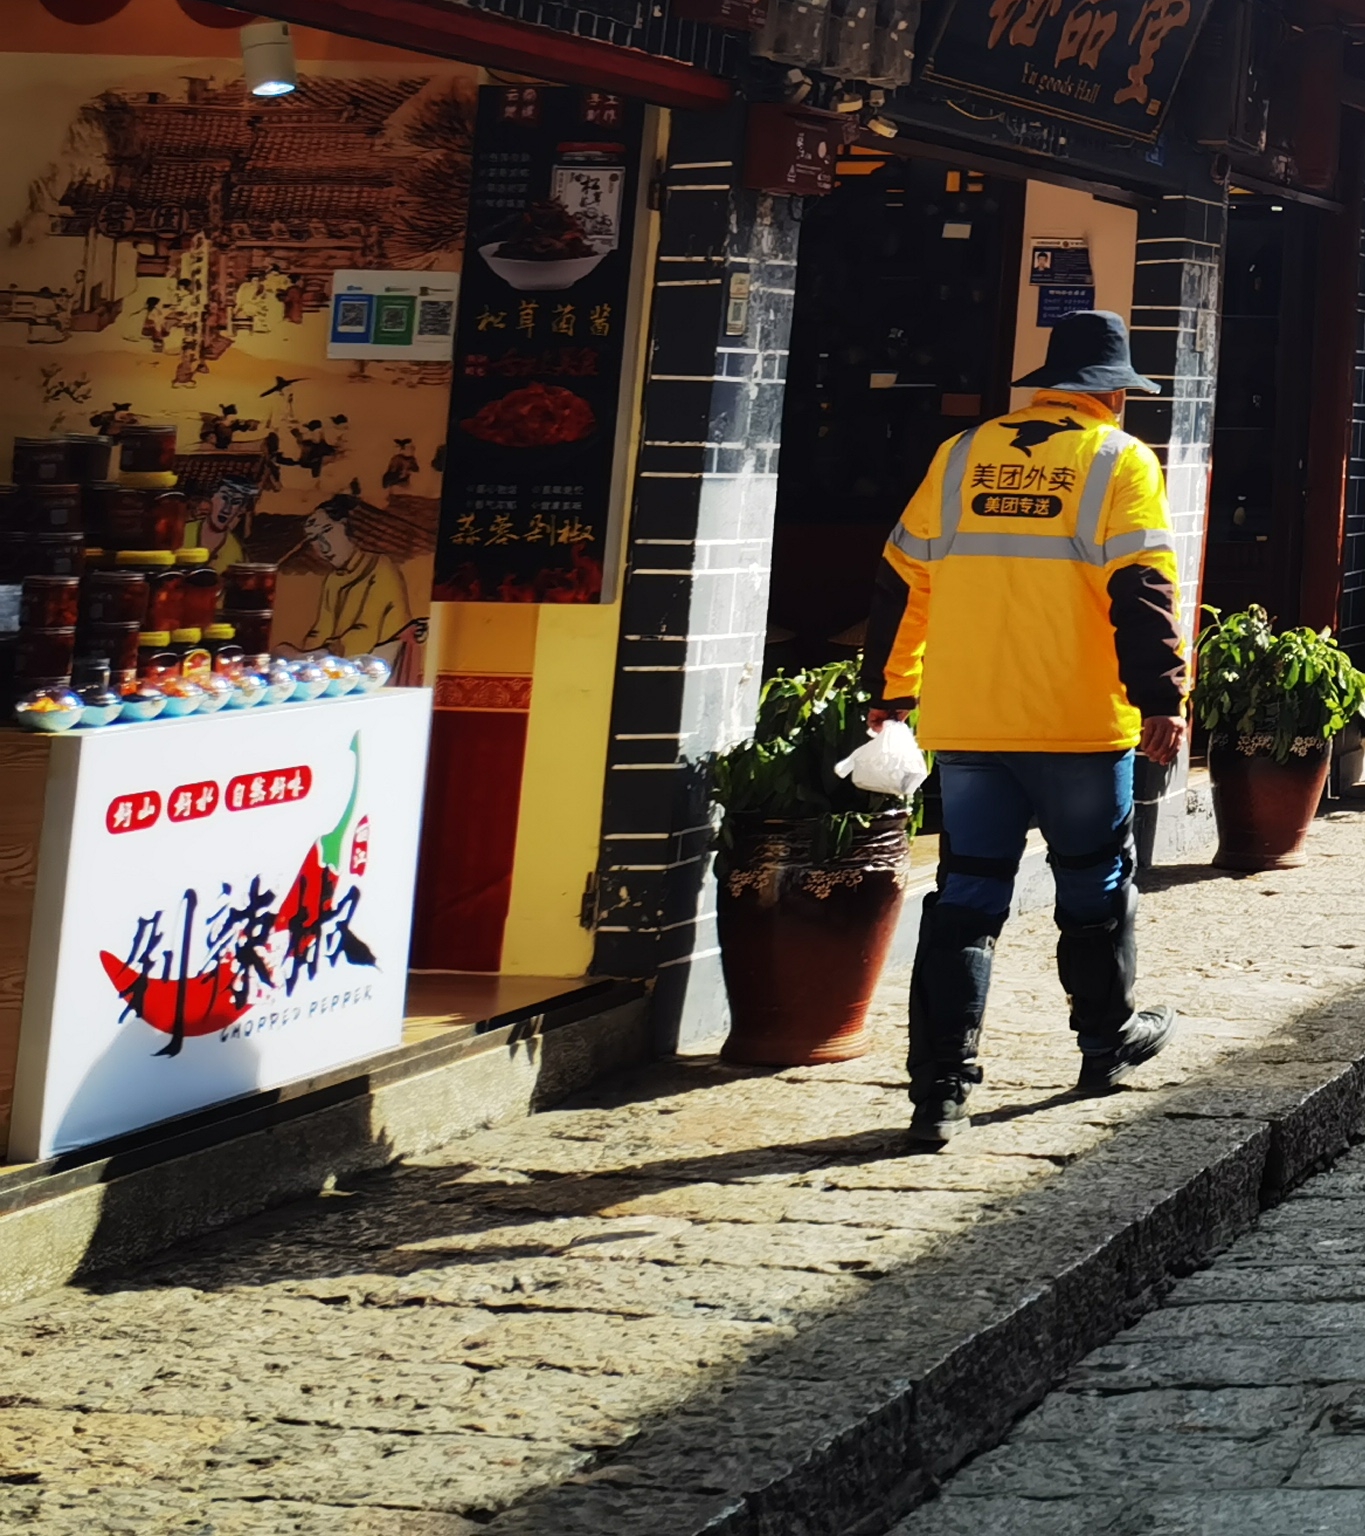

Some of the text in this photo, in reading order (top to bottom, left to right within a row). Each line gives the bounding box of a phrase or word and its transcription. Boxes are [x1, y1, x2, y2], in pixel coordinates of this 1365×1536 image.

[970, 463, 1076, 493] 美团外卖
[984, 496, 1051, 516] 美团专送
[113, 769, 305, 829] 好山 好水 自然好味
[219, 985, 373, 1043] CHOPPED PEPPER
